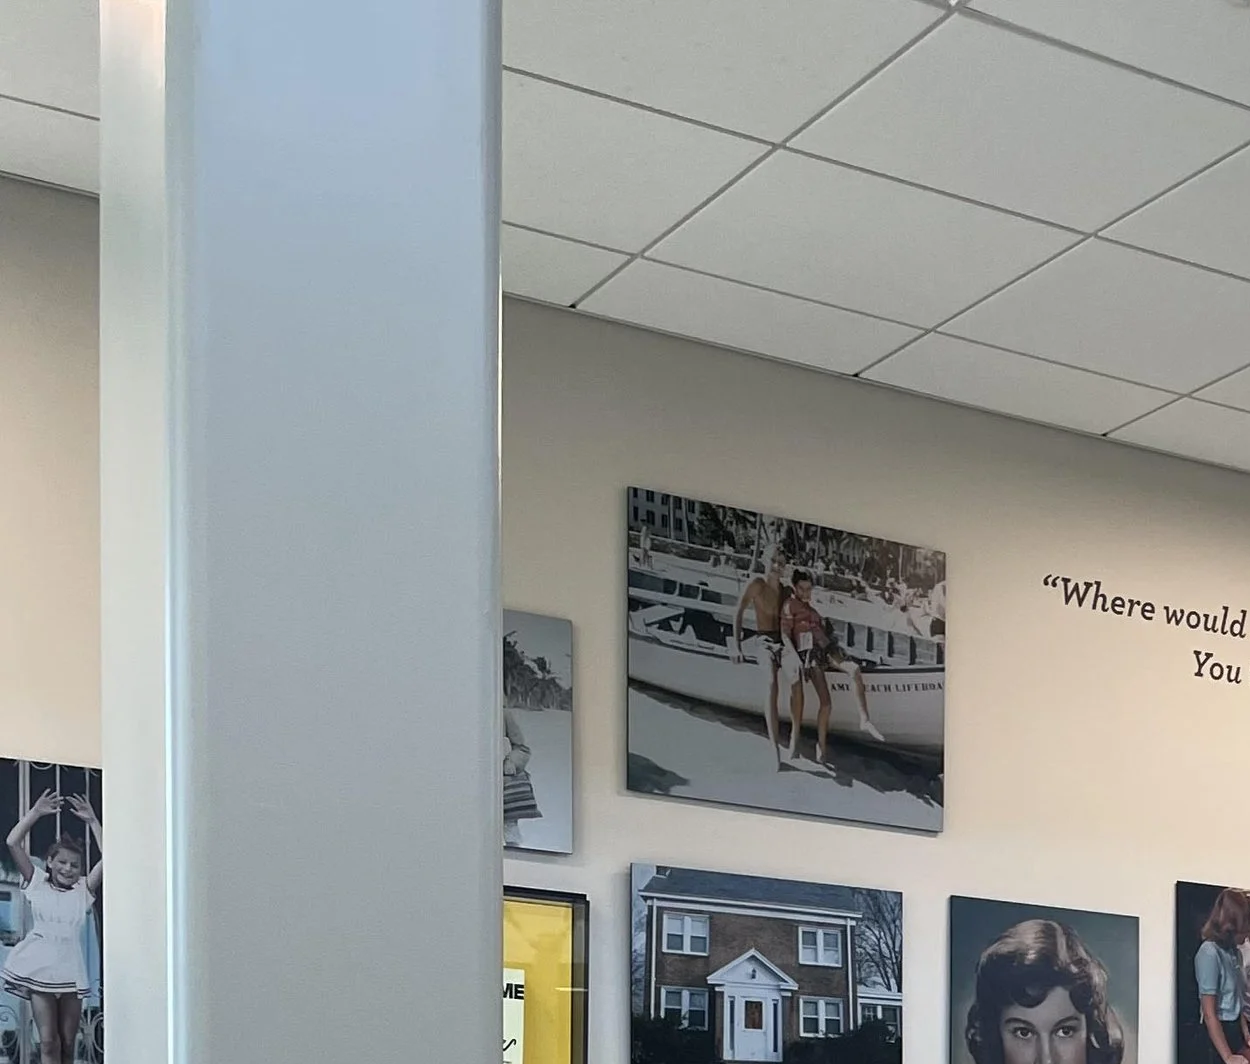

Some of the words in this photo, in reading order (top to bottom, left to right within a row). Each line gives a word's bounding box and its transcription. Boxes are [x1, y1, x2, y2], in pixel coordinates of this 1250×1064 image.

[1043, 573, 1155, 621] “Where
[1163, 605, 1247, 639] would
[1193, 649, 1242, 685] You
[863, 683, 892, 693] EACH
[895, 682, 944, 693] LIFEBOA
[503, 983, 525, 1000] ME
